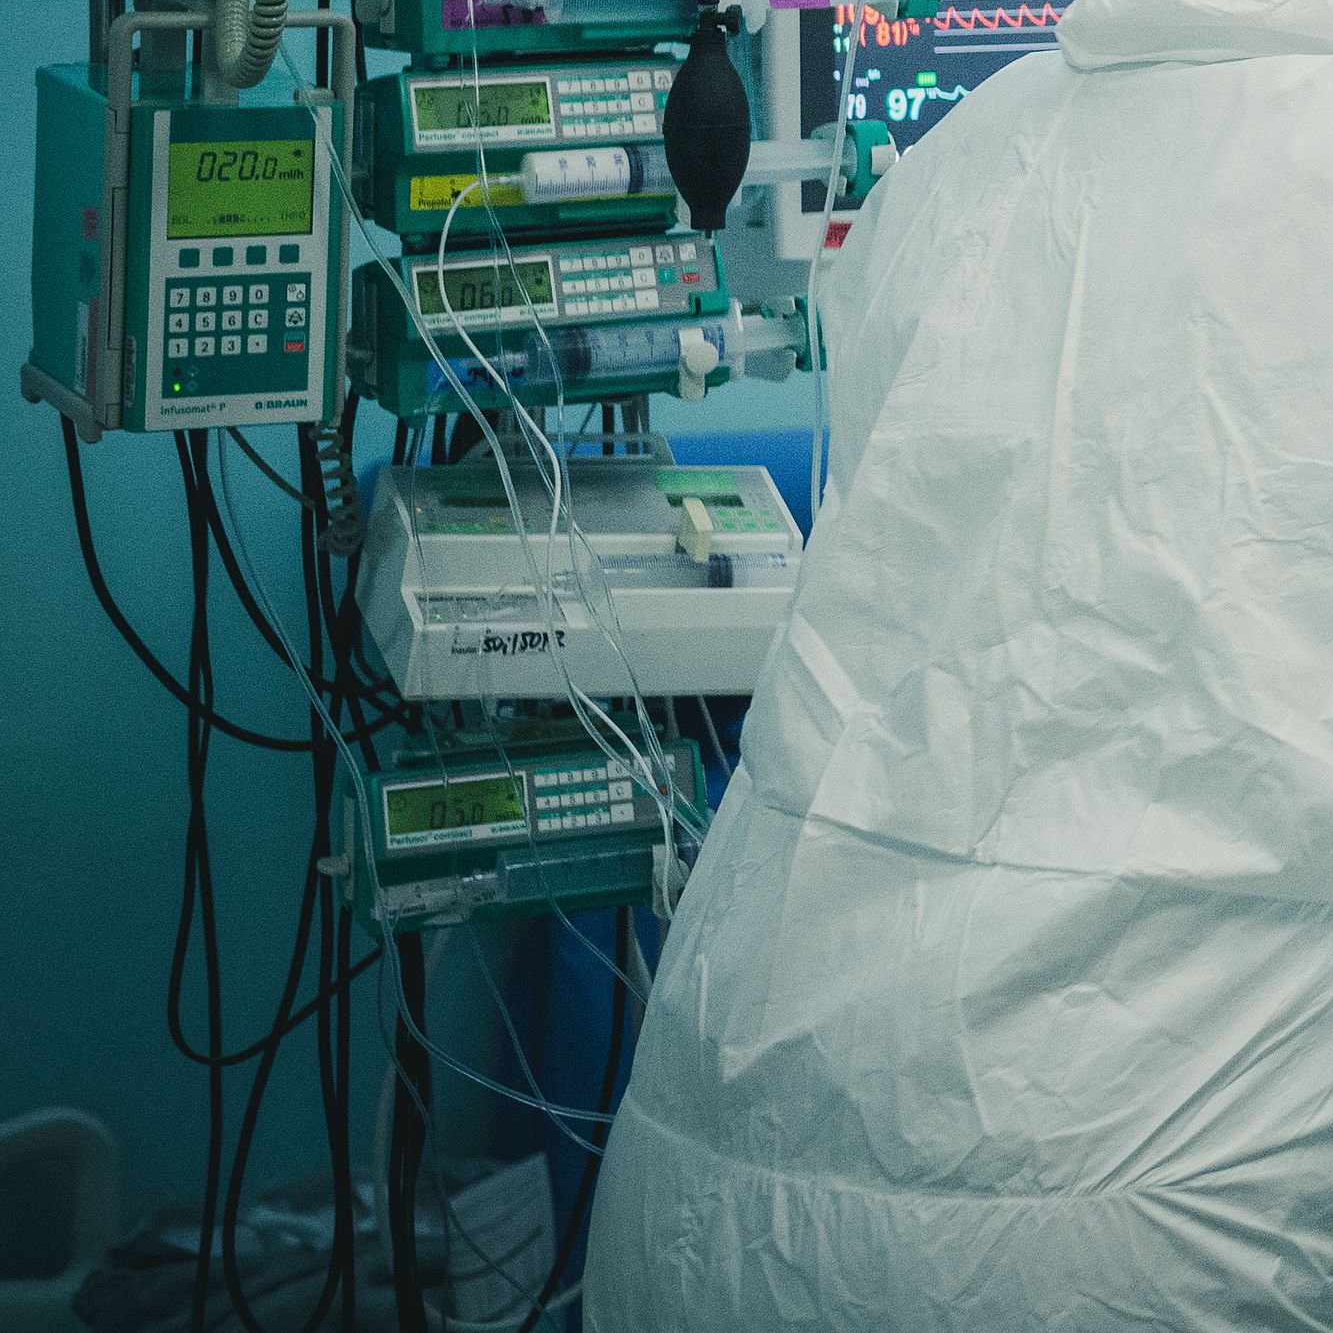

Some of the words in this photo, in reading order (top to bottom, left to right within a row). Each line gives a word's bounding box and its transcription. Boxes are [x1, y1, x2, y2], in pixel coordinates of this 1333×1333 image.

[887, 88, 926, 122] 97
[177, 293, 183, 304] 7
[203, 292, 210, 303] 8
[230, 290, 237, 302] 9
[255, 290, 263, 301] 0
[176, 318, 182, 328] 4
[203, 317, 209, 328] 5
[228, 316, 236, 327] 6
[254, 313, 262, 326] C
